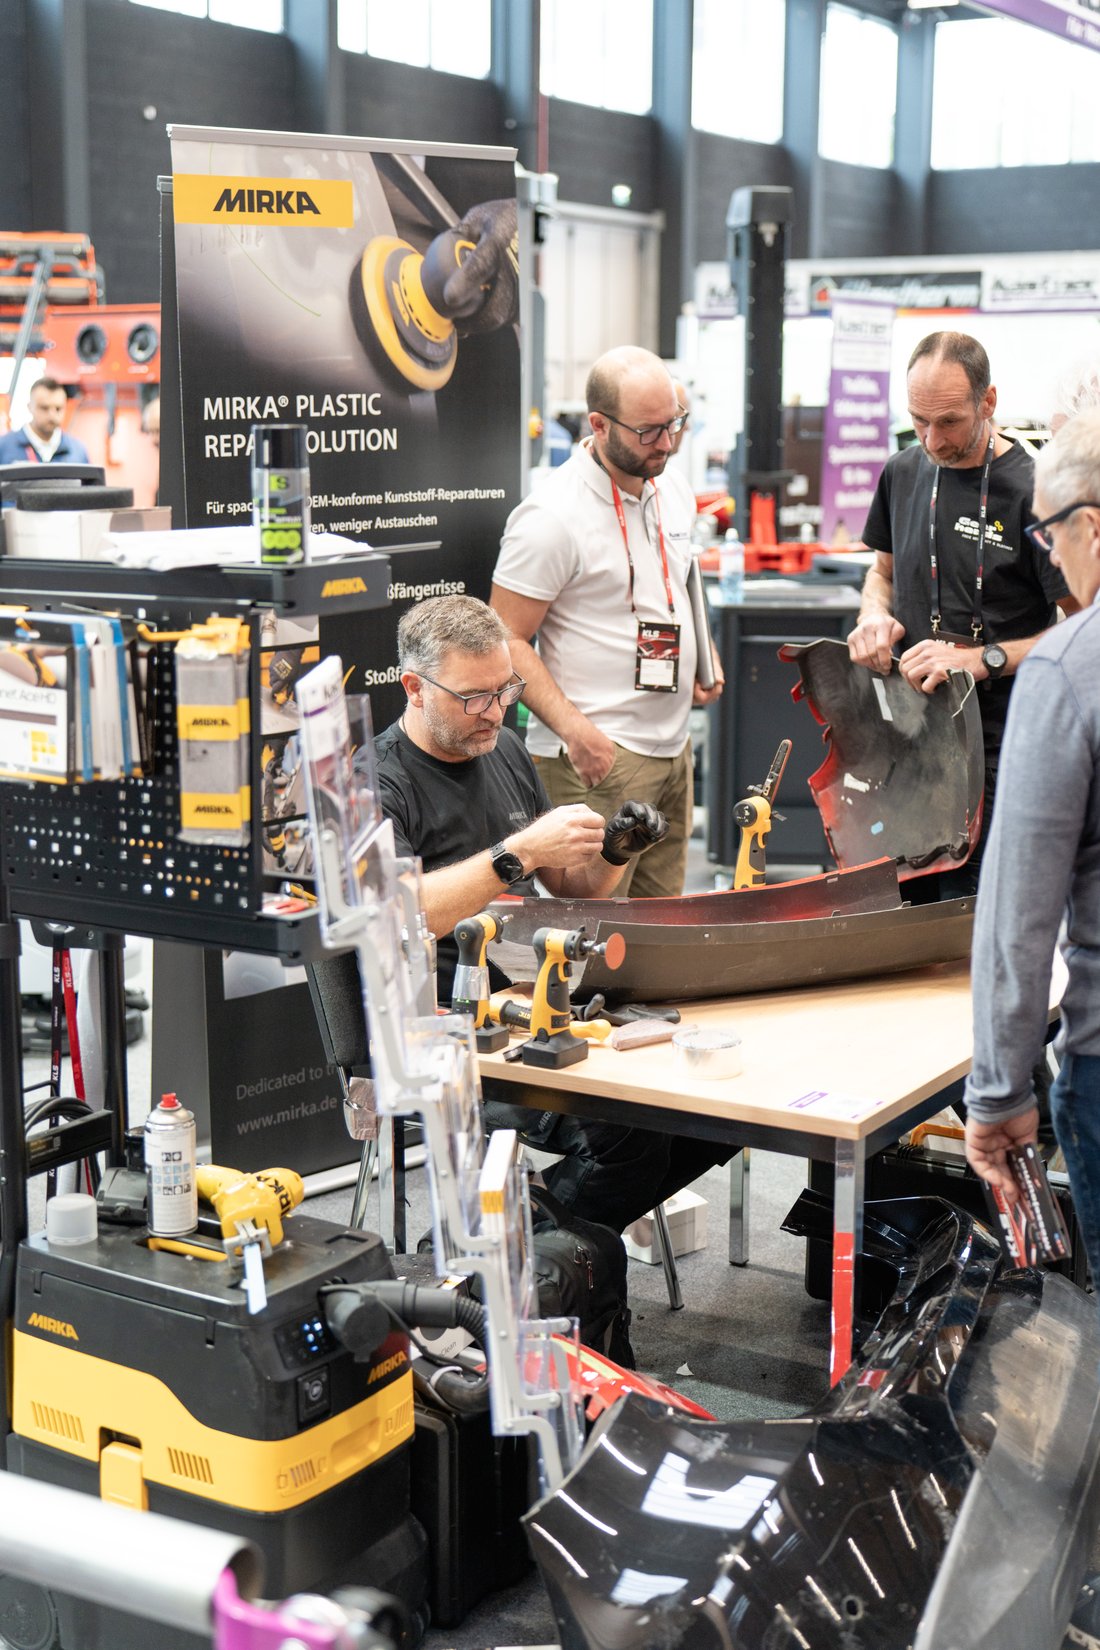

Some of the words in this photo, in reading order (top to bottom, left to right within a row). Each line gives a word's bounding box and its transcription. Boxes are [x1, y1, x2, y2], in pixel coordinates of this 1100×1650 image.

[213, 188, 321, 215] MIRKA
[296, 393, 381, 417] PLASTIC
[205, 434, 256, 458] REPA
[305, 428, 397, 454] OLUTION
[206, 501, 225, 515] Für
[227, 502, 254, 516] spac
[385, 488, 505, 505] Kunststoff-Reparaturen
[310, 522, 329, 533] ren,
[330, 517, 373, 534] weniger
[374, 513, 438, 530] Austauschen
[321, 577, 368, 598] MIRKA
[386, 579, 466, 601] ßfängerrisse
[364, 665, 402, 686] Stoßf
[236, 1068, 306, 1100] Dedicated
[309, 1066, 323, 1080] to
[237, 1095, 338, 1135] www.mirka.de
[537, 1111, 553, 1133] MIR
[27, 1311, 80, 1341] MIRKA
[367, 1350, 408, 1385] MIRKA
